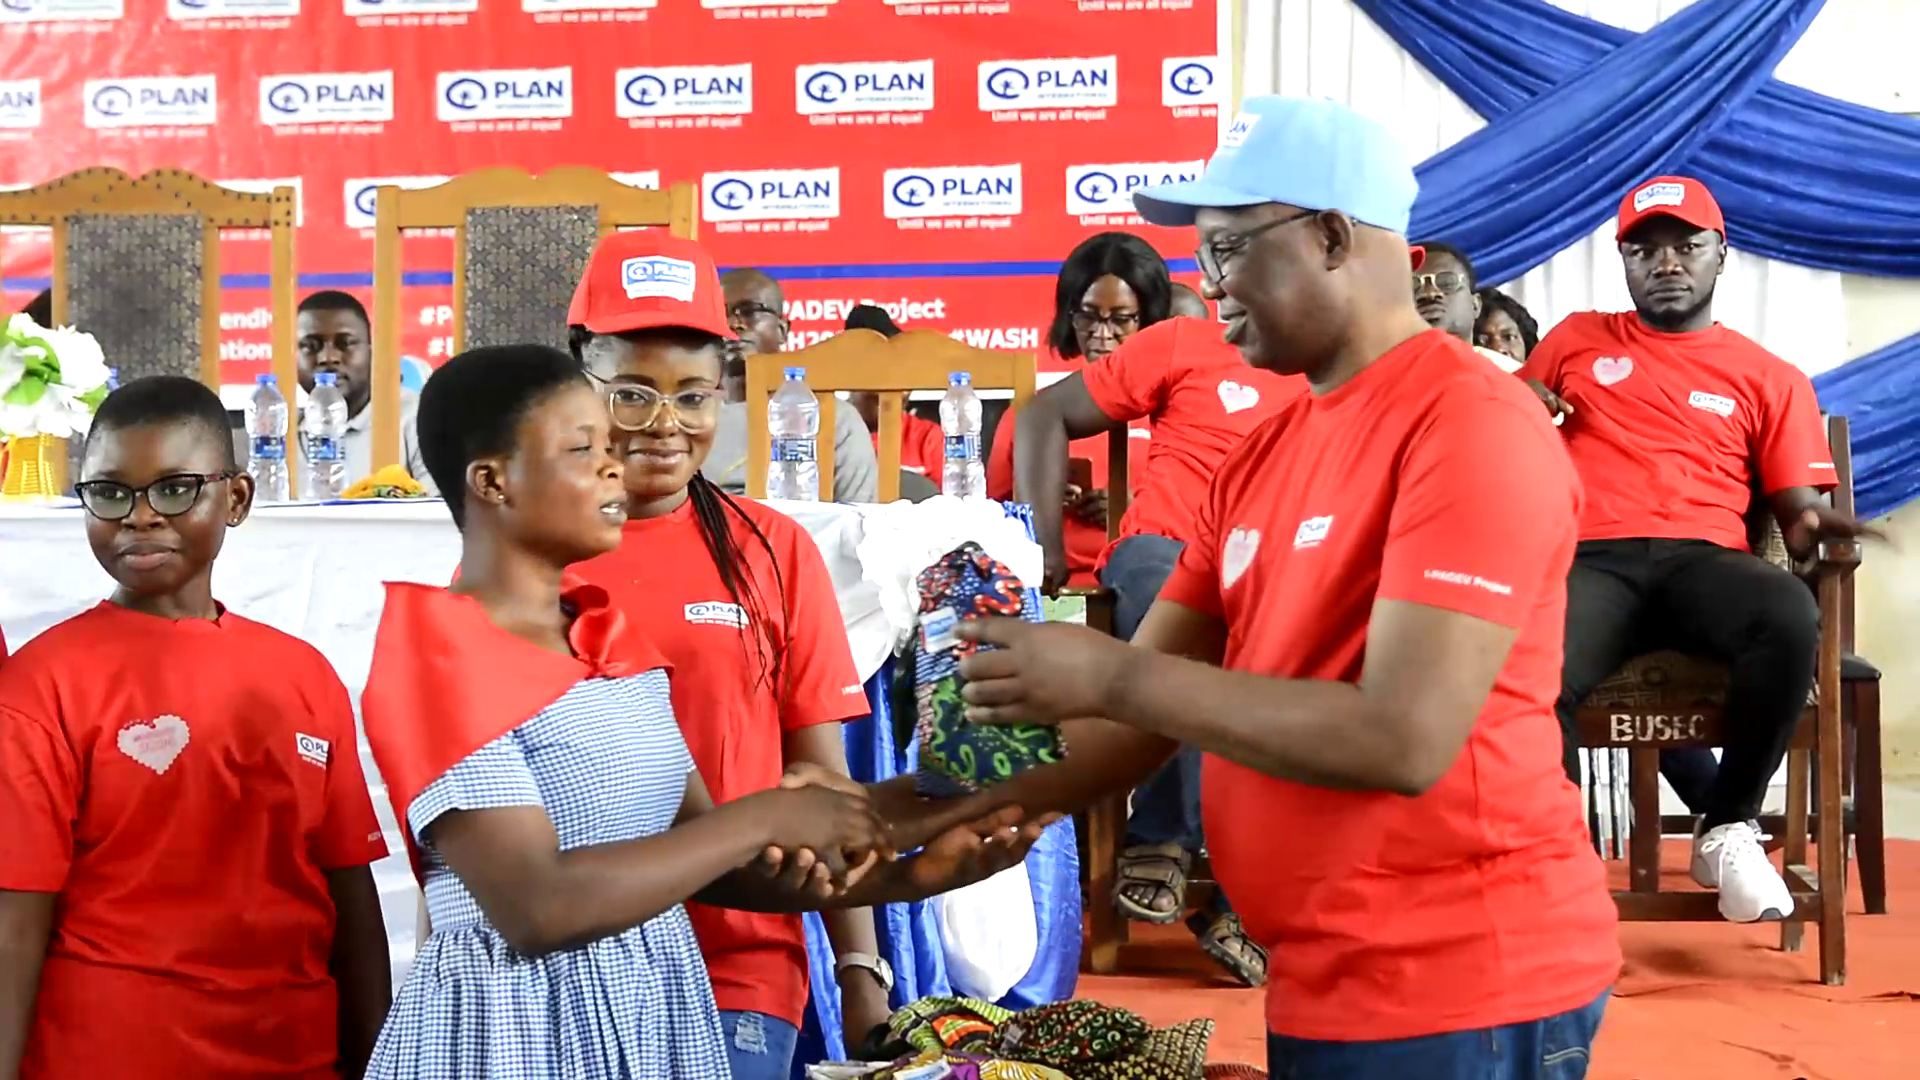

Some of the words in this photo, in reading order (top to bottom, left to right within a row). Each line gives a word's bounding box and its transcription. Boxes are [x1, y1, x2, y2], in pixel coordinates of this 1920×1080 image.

[674, 77, 743, 95] PLAN
[855, 73, 924, 91] PLAN
[1038, 69, 1107, 87] PLAN
[140, 88, 208, 105] PLAN
[316, 84, 385, 102] PLAN
[494, 80, 563, 98] PLAN
[761, 181, 829, 199] PLAN
[943, 177, 1012, 195] PLAN
[949, 328, 1038, 349] #WASH
[1611, 714, 1706, 742] BUSEC
